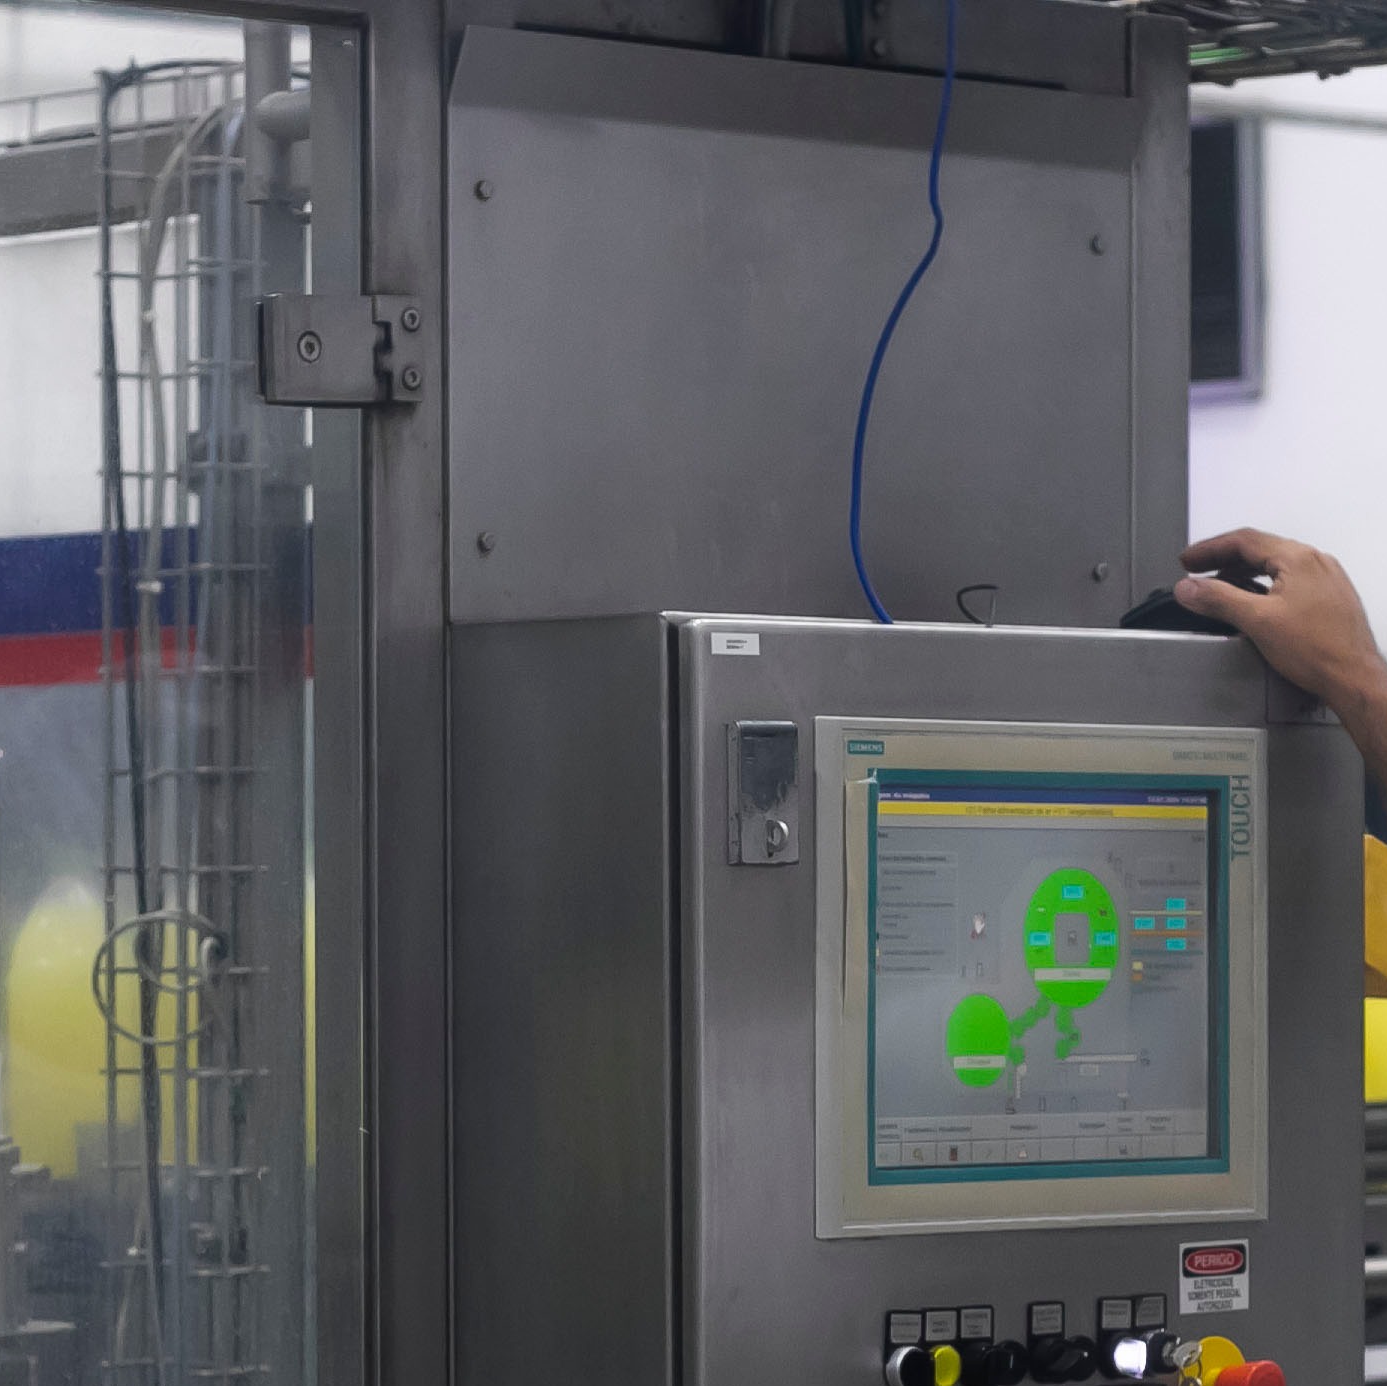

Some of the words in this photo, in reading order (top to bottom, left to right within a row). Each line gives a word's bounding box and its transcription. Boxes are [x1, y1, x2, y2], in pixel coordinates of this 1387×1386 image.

[848, 741, 884, 753] SIEMENS
[1227, 752, 1249, 761] PANEL
[1231, 775, 1251, 861] TOUCH
[1194, 1252, 1235, 1268] PERIGO
